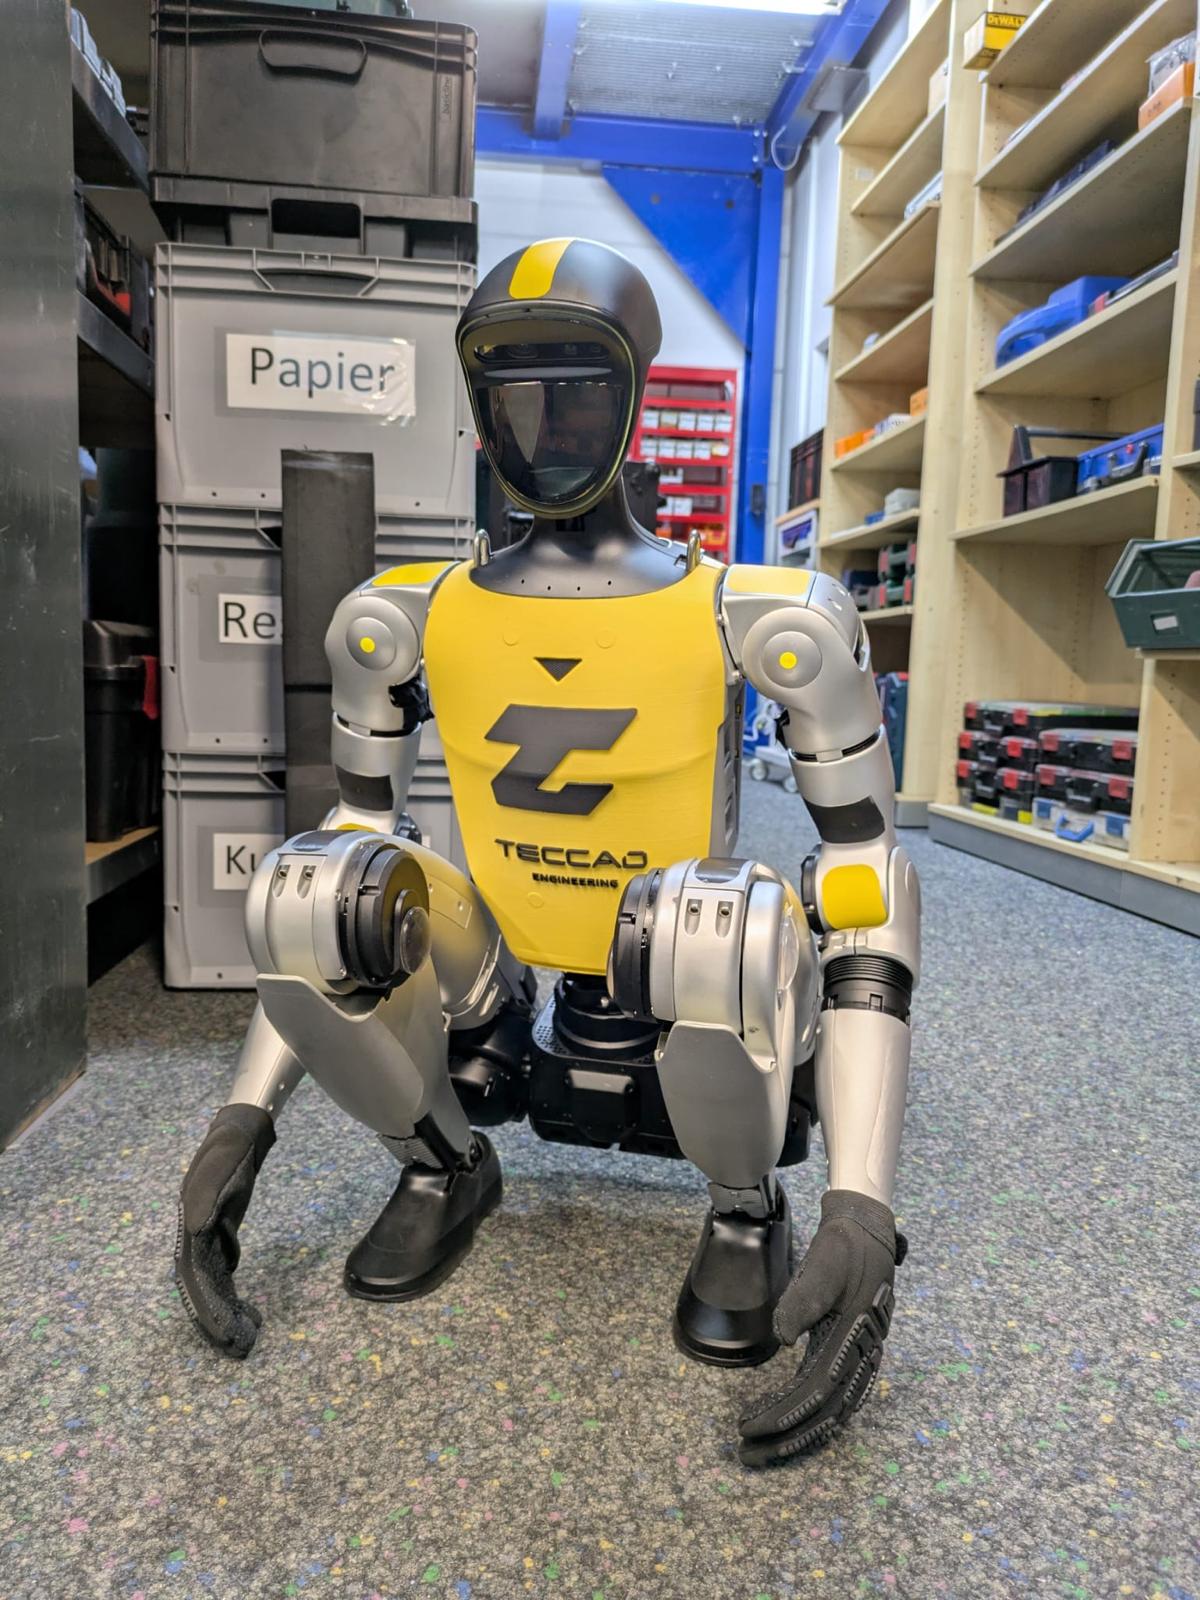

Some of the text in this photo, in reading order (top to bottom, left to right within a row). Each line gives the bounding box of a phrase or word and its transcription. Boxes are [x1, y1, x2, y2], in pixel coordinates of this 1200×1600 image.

[251, 347, 395, 398] Papier
[224, 602, 279, 639] Re
[495, 838, 648, 869] TECCAD
[532, 872, 618, 888] ENGINEERING
